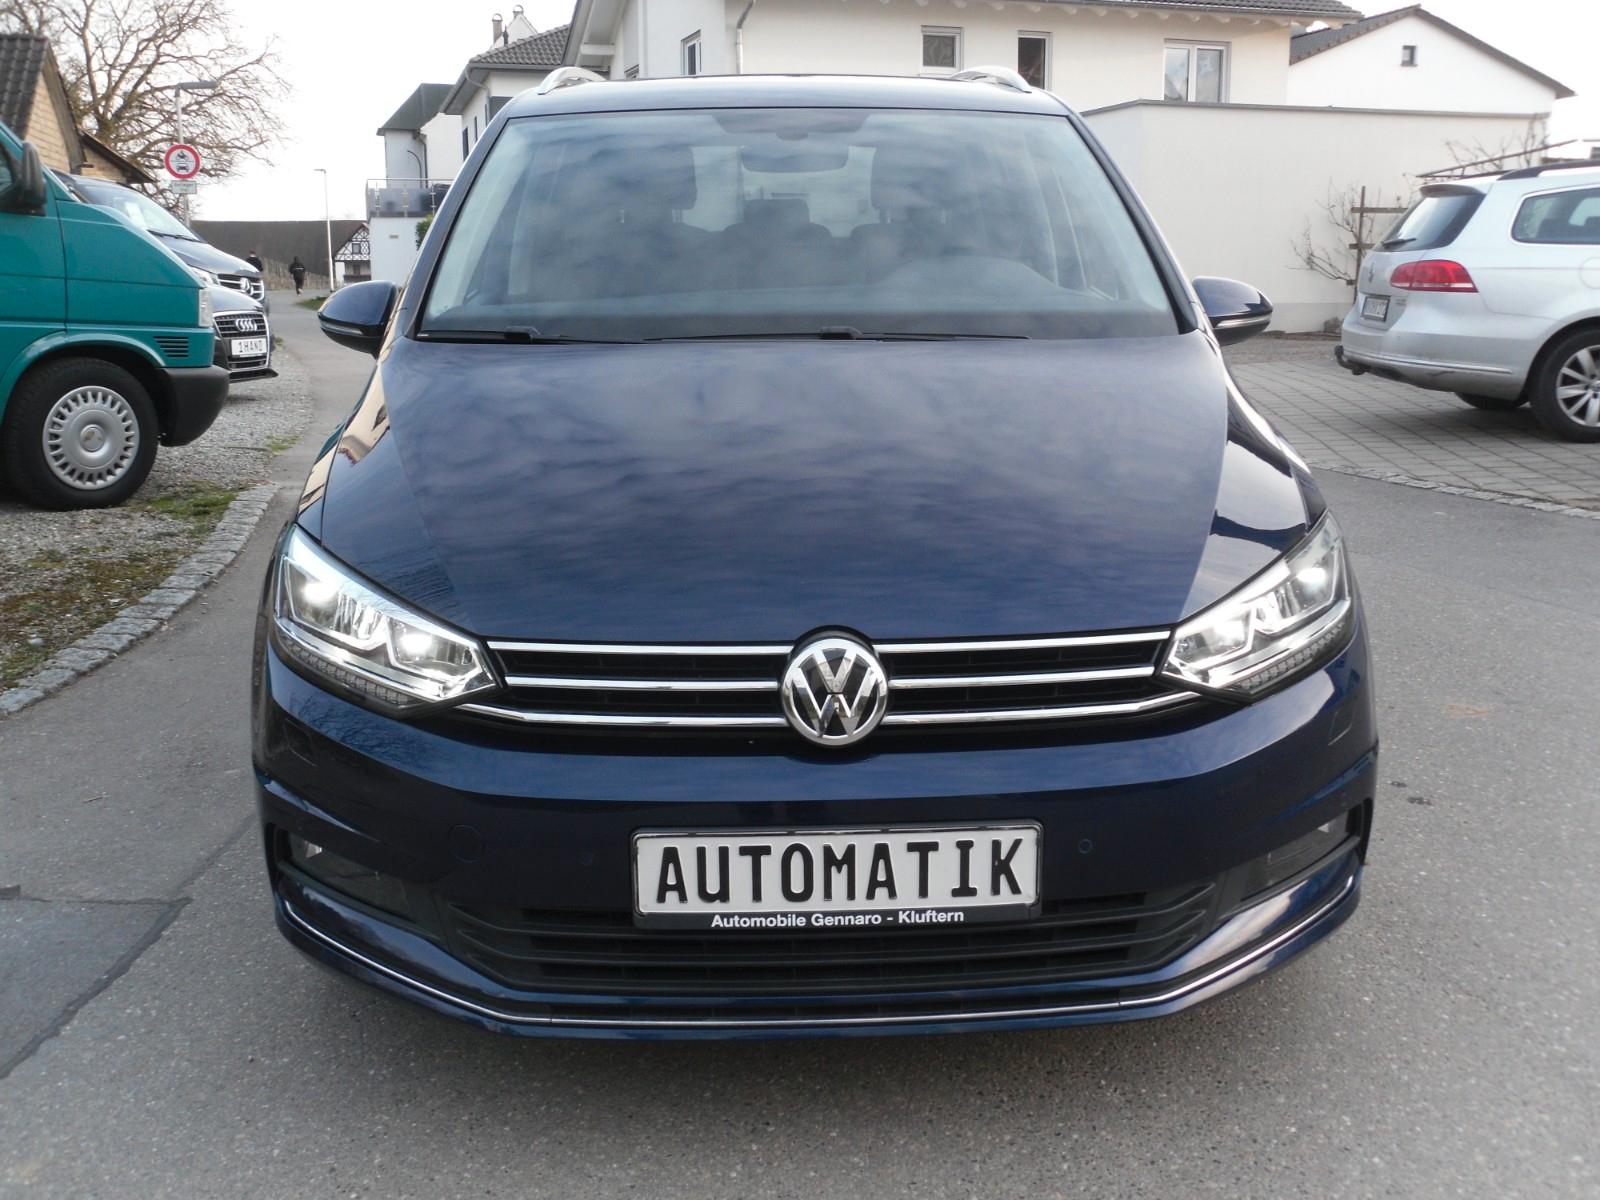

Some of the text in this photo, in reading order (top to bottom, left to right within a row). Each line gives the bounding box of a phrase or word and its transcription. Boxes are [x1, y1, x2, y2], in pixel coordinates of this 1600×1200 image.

[785, 642, 885, 742] VW
[655, 837, 1024, 904] AUTOMATIK
[711, 912, 806, 928] Automobile
[811, 912, 882, 927] Gennaro
[898, 909, 964, 924] Kluftern
